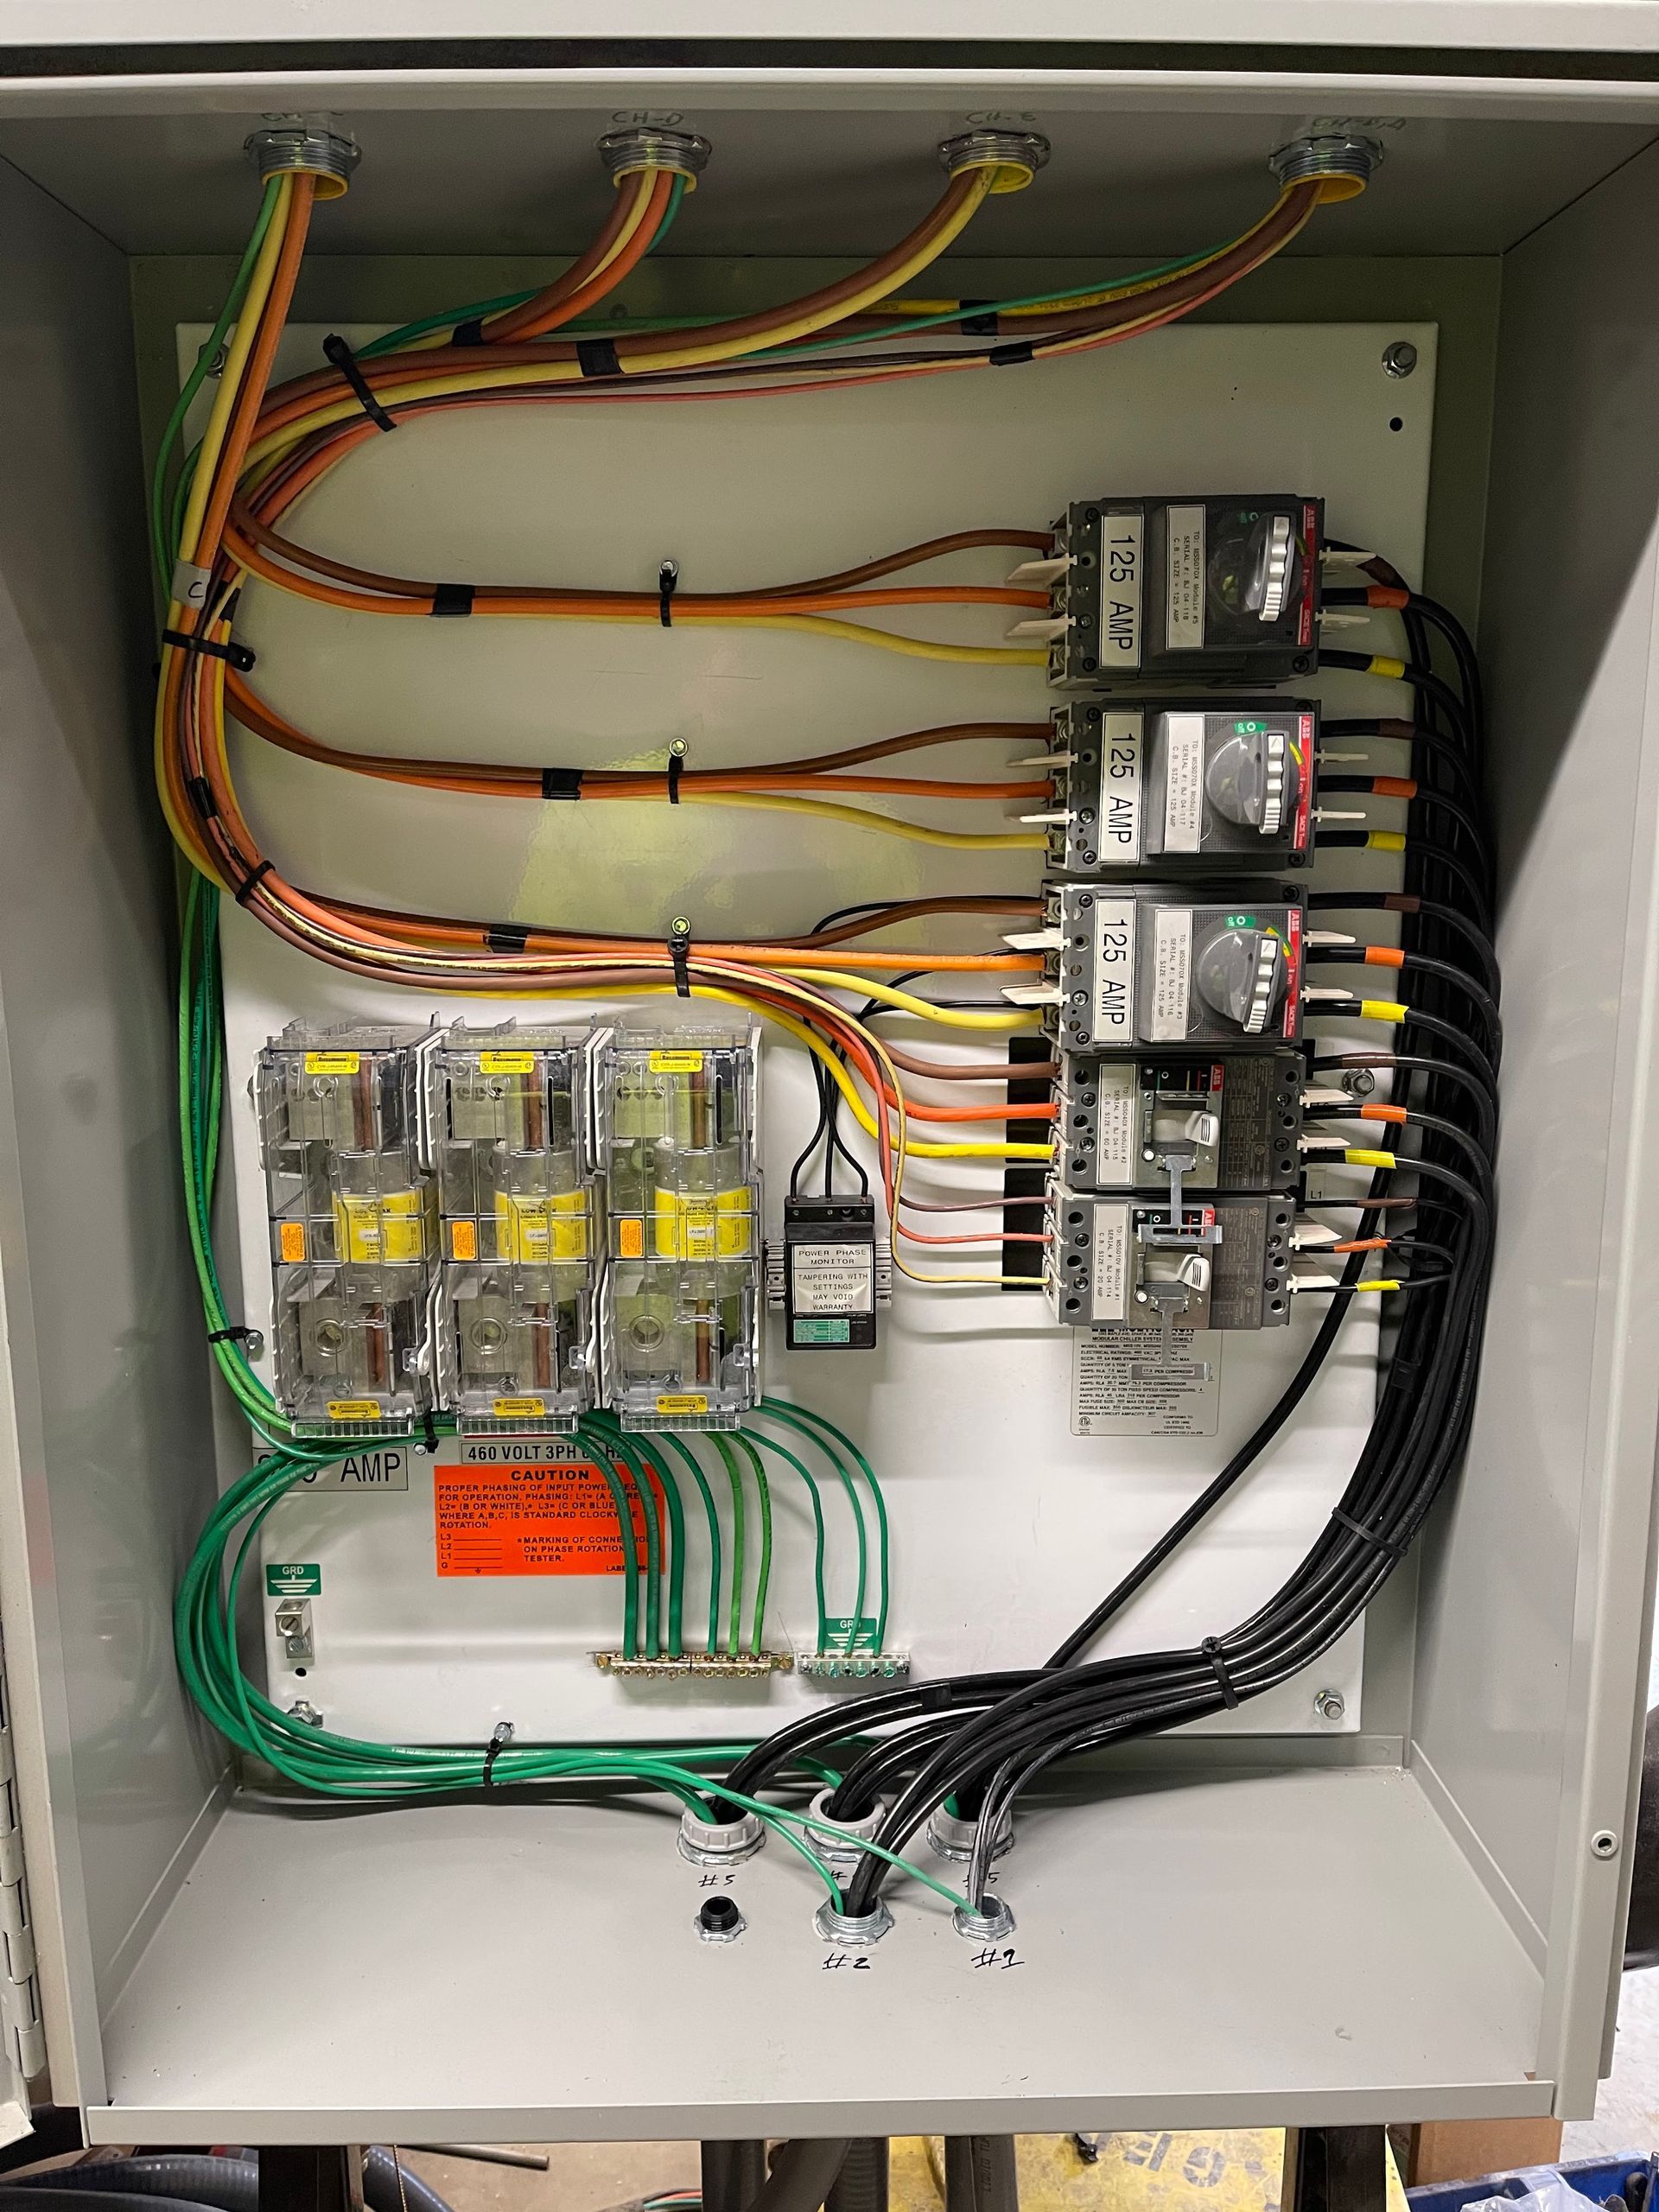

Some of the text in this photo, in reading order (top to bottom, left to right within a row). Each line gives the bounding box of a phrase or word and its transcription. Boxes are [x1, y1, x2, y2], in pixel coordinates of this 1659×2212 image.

[188, 581, 203, 598] C
[1109, 534, 1135, 650] 125 AMP
[1108, 733, 1135, 843] 125 AMP
[1102, 918, 1128, 1025] 125 AMP
[468, 1447, 497, 1459] 460
[502, 1446, 541, 1459] VOLT
[546, 1446, 576, 1459] 3PH
[340, 1453, 401, 1482] AMP
[512, 1471, 589, 1481] CAUTION
[283, 1566, 304, 1574] GRD
[822, 1953, 872, 1970] #2
[970, 1948, 1025, 1969] #1
